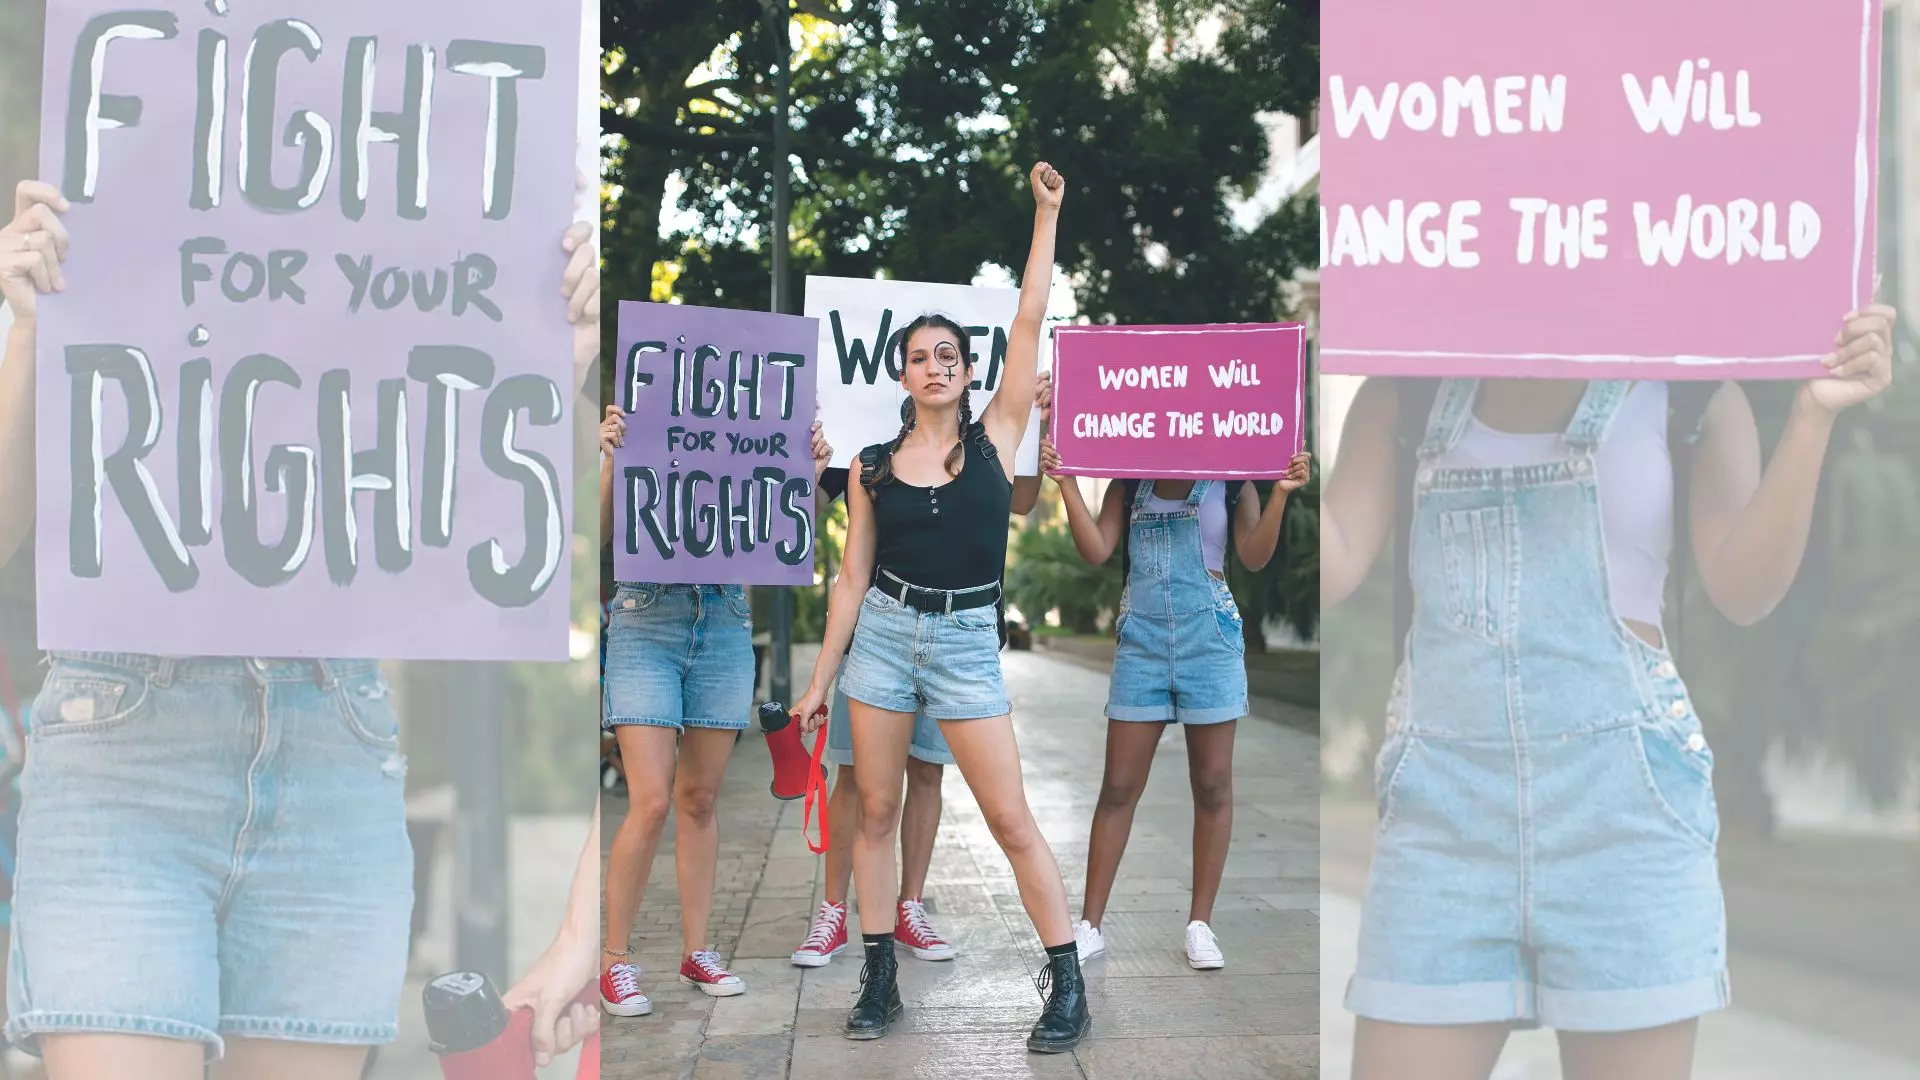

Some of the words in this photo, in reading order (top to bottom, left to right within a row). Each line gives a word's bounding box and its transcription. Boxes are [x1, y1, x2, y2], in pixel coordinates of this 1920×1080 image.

[1328, 74, 1568, 141] WOMEN
[1320, 198, 1482, 269] ANGE
[1509, 197, 1608, 269] THE
[1632, 193, 1822, 267] WORLD
[179, 238, 309, 306] FOR
[335, 249, 503, 322] YOUR
[1098, 365, 1188, 391] WOMEN
[667, 426, 716, 452] FOR
[726, 432, 790, 459] YOUR
[1073, 411, 1156, 438] CHANGE
[1166, 411, 1204, 439] THE
[1212, 409, 1284, 438] WORLD
